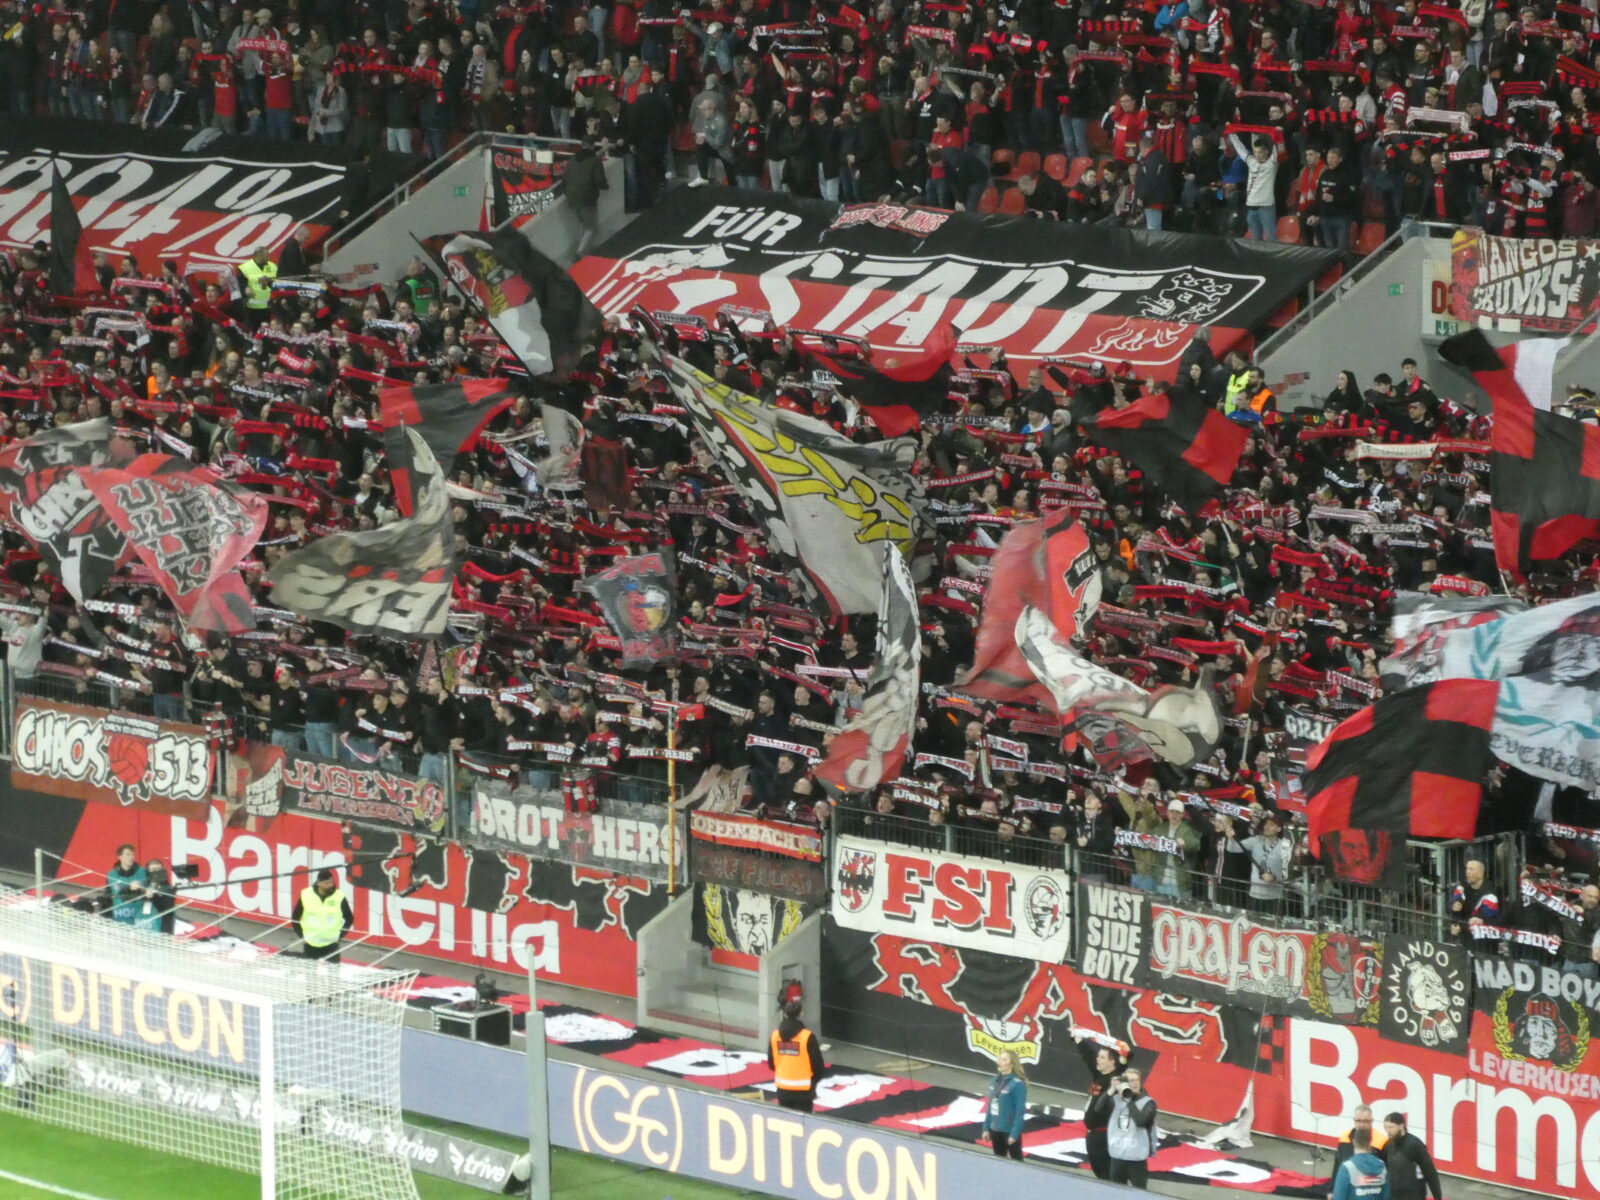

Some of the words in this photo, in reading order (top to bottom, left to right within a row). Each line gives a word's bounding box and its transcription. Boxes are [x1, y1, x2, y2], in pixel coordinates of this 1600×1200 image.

[683, 206, 803, 246] FÜR
[715, 250, 1168, 353] STADT
[15, 708, 117, 787] CHAOS
[150, 732, 211, 801] 513
[281, 760, 419, 810] JUGEND
[474, 790, 564, 850] BROT
[591, 814, 682, 867] HERS
[881, 853, 1014, 936] FSI
[1088, 885, 1145, 922] WEST
[1087, 915, 1142, 956] SIDE
[1082, 948, 1140, 986] BOYZ
[1473, 956, 1536, 993] MAD
[1387, 940, 1449, 1037] COMMANDO
[1447, 969, 1466, 1024] 1989
[50, 963, 246, 1064] DITCON
[97, 1070, 142, 1096] trive
[173, 1085, 222, 1112] trive
[398, 1135, 438, 1164] trive
[462, 1153, 506, 1183] trive
[706, 1105, 938, 1200] DITCON
